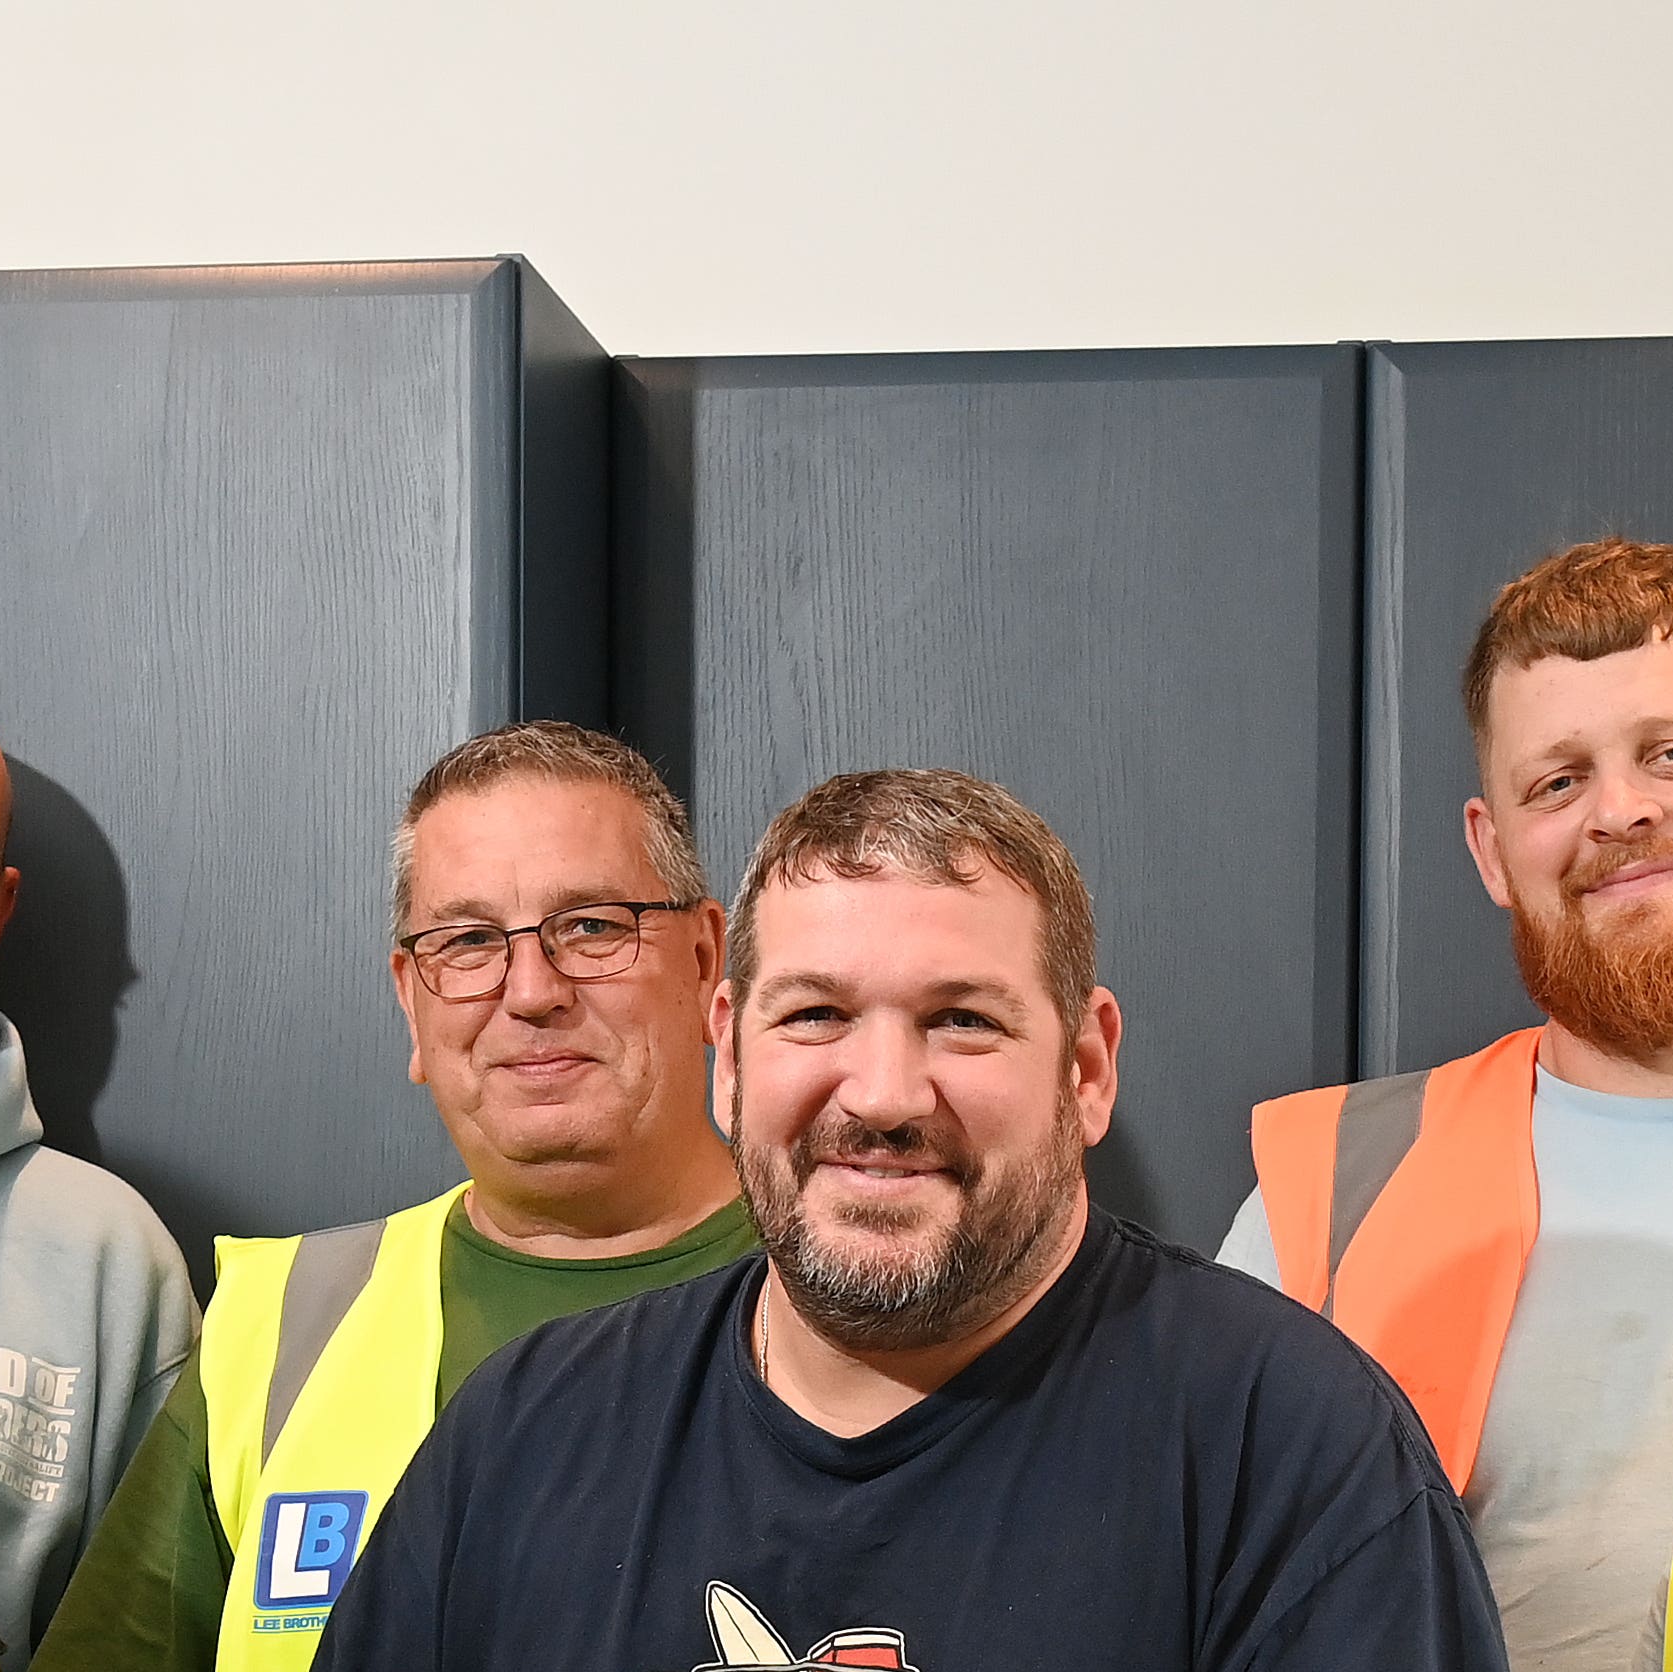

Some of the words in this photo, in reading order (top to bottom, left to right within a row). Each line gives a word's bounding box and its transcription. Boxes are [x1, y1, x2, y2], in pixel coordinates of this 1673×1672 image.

[34, 1367, 78, 1409] OF
[254, 1619, 281, 1630] LEE
[283, 1616, 327, 1630] BROTH
